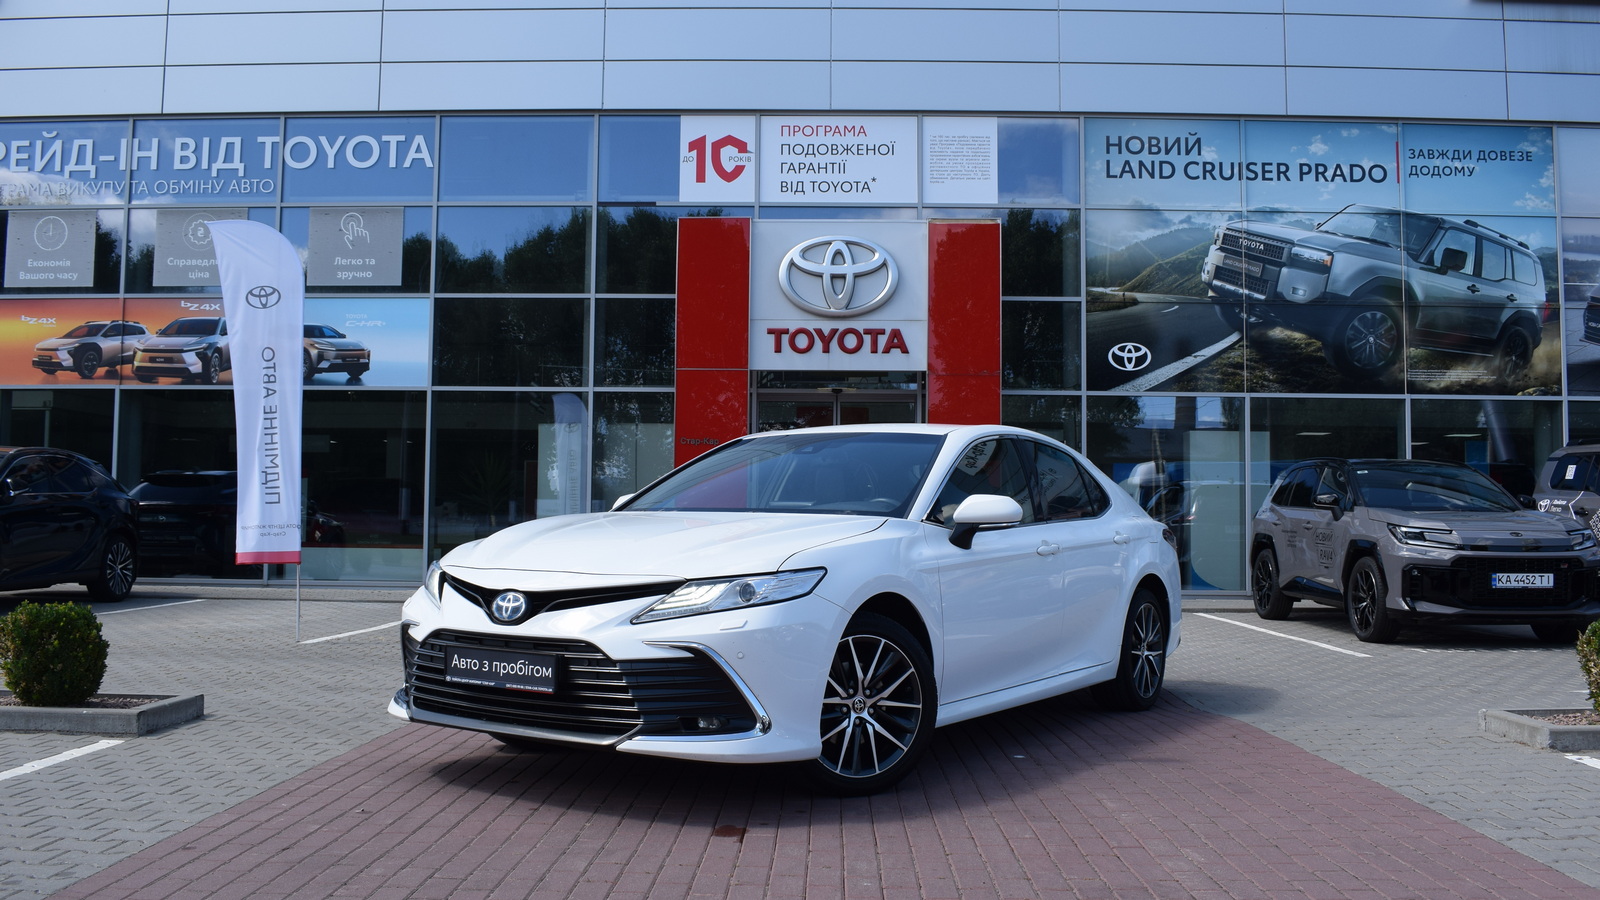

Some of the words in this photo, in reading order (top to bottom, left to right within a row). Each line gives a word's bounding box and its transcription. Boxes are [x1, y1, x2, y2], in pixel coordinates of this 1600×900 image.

[780, 125, 867, 137] ПРОГРАМА
[780, 140, 896, 158] ПОДОВЖЕНОЇ
[1105, 132, 1203, 156] НОВИЙ
[173, 136, 245, 178] ВІД
[257, 135, 434, 170] TOYOTA
[682, 155, 695, 163] ДО
[728, 155, 752, 163] РОКІВ
[1408, 148, 1473, 163] ЗАВЖДИ
[1476, 149, 1533, 164] ДОВЕЗЕ
[780, 159, 848, 174] ГАРАНТІЇ
[1105, 159, 1176, 180] LAND
[1183, 160, 1291, 183] CRUISER
[1298, 163, 1388, 184] PRADO
[1408, 165, 1476, 178] ДОДОМУ
[58, 180, 126, 197] ВИКУПУ
[130, 180, 148, 194] ТА
[154, 179, 225, 194] ОБМІНУ
[229, 179, 274, 194] АВТО
[780, 181, 806, 195] ВІД
[1239, 239, 1264, 250] TOYOTA
[27, 259, 71, 267] Економія
[334, 257, 361, 266] Легко
[19, 271, 54, 280] Вашого
[57, 272, 78, 281] часу
[188, 269, 209, 279] ціна
[336, 269, 372, 279] зручно
[766, 327, 910, 355] TOYOTA
[680, 437, 720, 446] Стар-Кар
[1315, 530, 1333, 542] НОВИЙ
[1319, 549, 1333, 561] RAV4
[1514, 575, 1536, 585] 4452
[451, 654, 480, 670] Авто
[482, 660, 489, 671] з
[492, 660, 552, 678] пробігом
